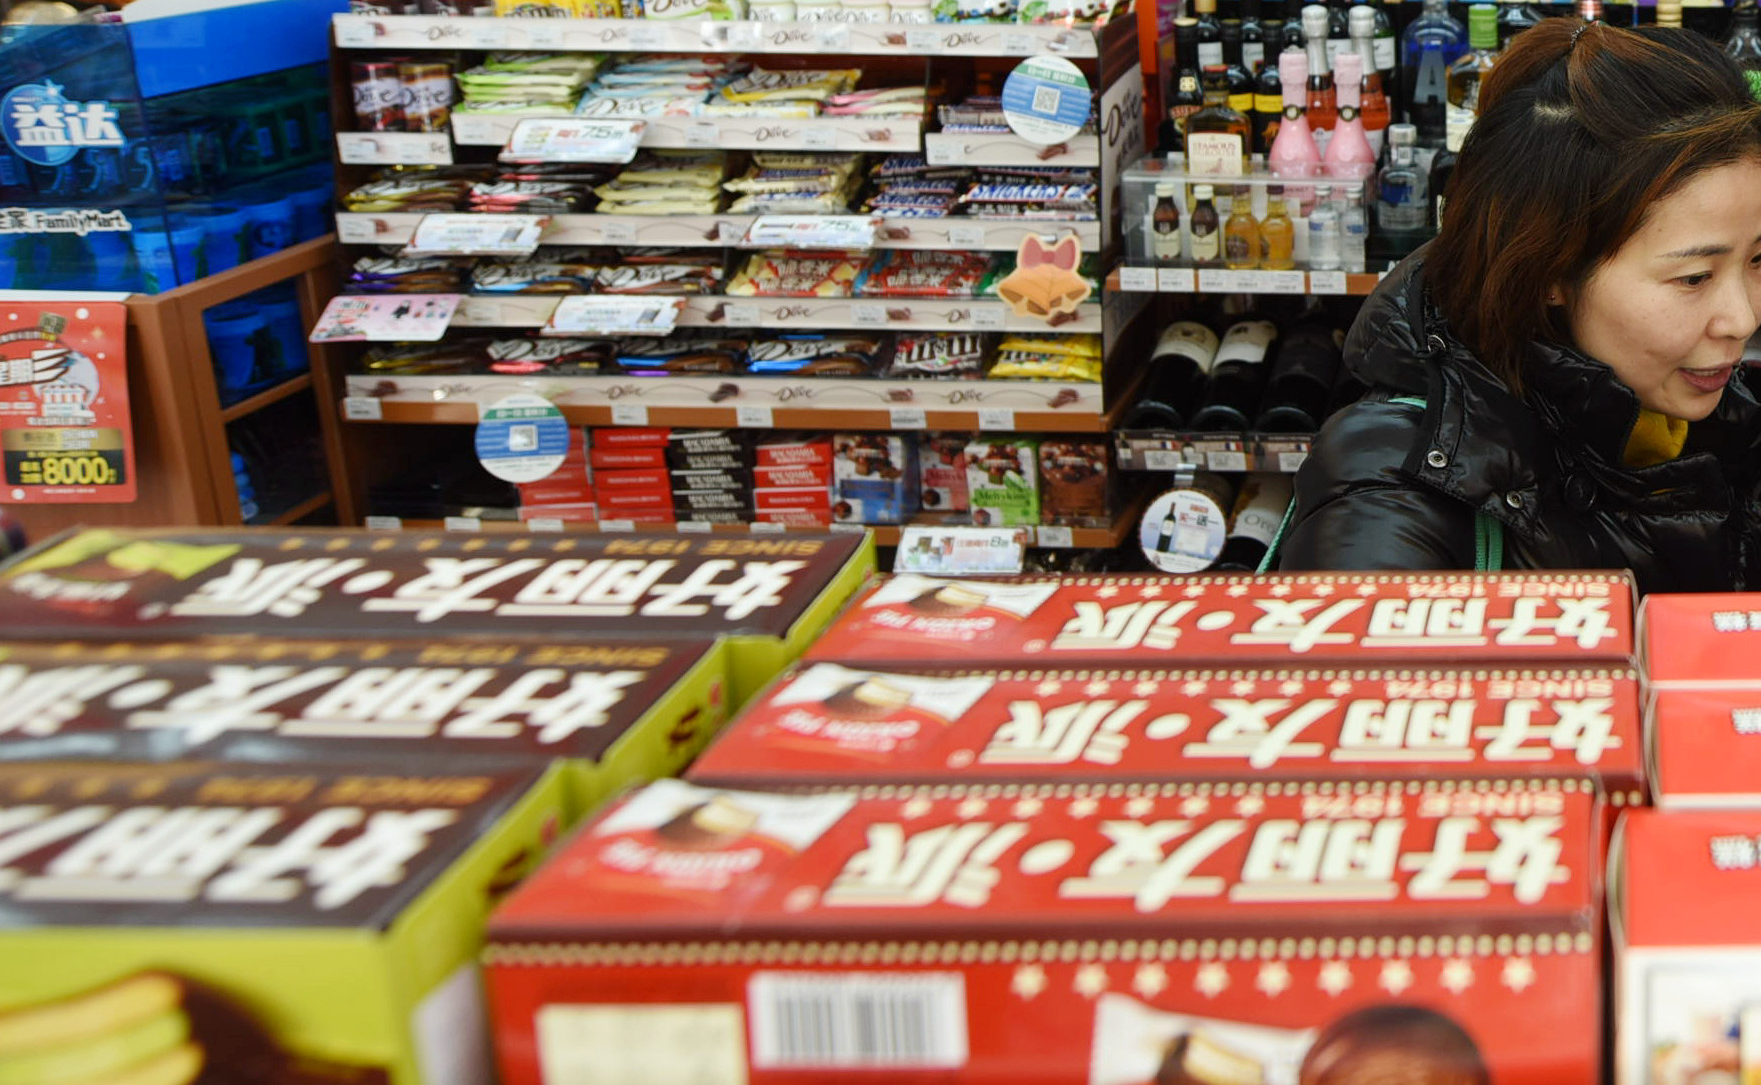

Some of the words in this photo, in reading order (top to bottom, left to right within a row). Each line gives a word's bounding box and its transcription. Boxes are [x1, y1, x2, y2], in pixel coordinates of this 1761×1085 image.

[11, 103, 124, 146] 益达
[37, 211, 125, 231] FamilyMart
[42, 457, 109, 485] 8000
[605, 539, 698, 556] 1974
[707, 539, 826, 556] SINCE
[172, 556, 809, 624] 好丽友·派
[1405, 580, 1491, 600] 1974
[1497, 579, 1613, 600] SINCE
[1049, 596, 1619, 653] 好丽友·派
[526, 645, 671, 667] SINCE
[1381, 681, 1479, 701] 1974
[1484, 679, 1615, 701] SINCE
[977, 698, 1624, 770] 好丽友·派
[327, 776, 494, 805] SINCE
[1418, 790, 1568, 819] SINCE
[1299, 791, 1407, 819] 1974
[820, 814, 1572, 913] 好丽友·派
